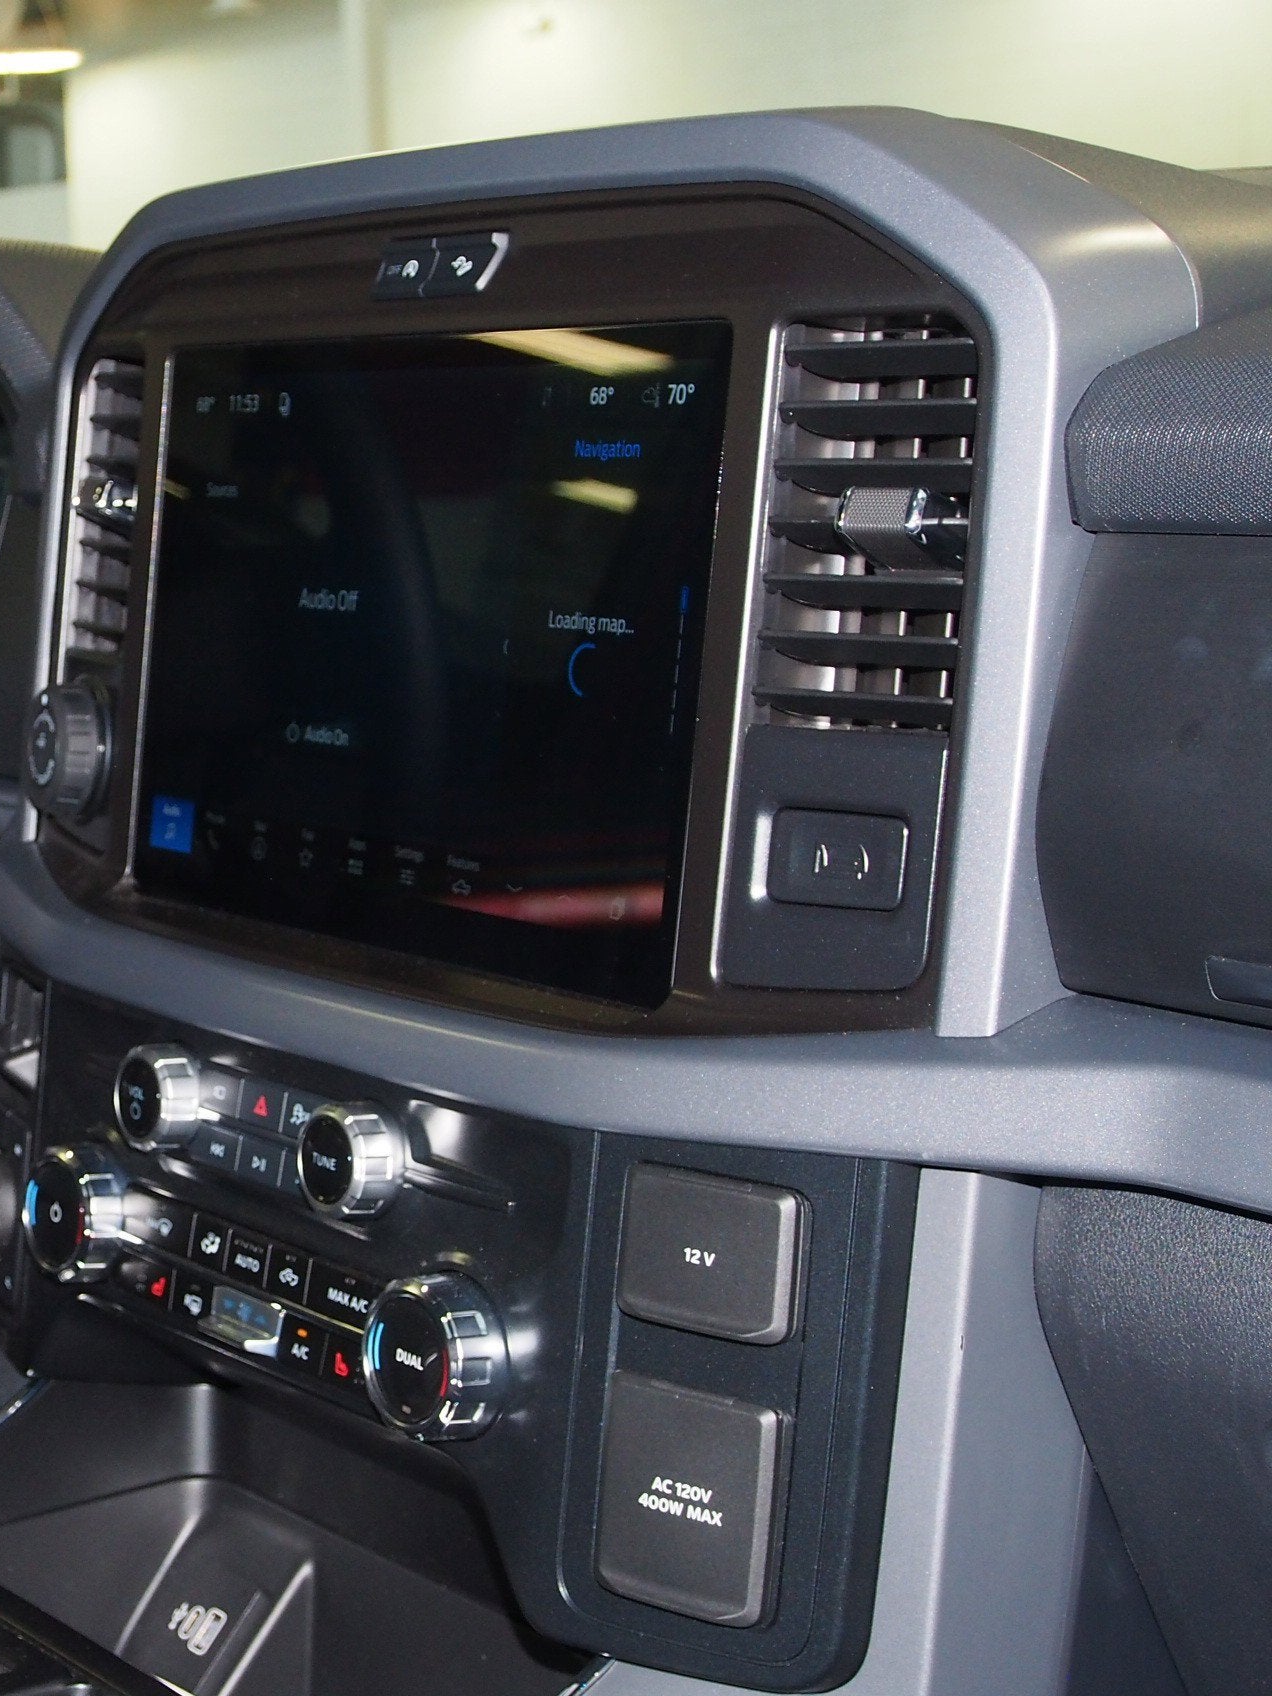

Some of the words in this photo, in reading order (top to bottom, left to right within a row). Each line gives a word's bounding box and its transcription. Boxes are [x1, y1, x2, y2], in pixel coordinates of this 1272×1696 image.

[589, 386, 615, 405] 68°
[667, 383, 695, 405] 70°
[574, 440, 640, 461] Navigation
[298, 587, 336, 610] Audio
[337, 589, 359, 612] Off
[548, 610, 596, 635] Loading
[597, 616, 634, 635] map...
[312, 1151, 337, 1171] TUNE
[234, 1253, 260, 1273] AUTO
[683, 1247, 701, 1265] 12
[703, 1251, 716, 1267] V
[327, 1287, 350, 1306] MAX
[350, 1297, 369, 1313] A/C
[291, 1343, 310, 1360] A/C
[395, 1347, 424, 1371] DUAL
[651, 1476, 673, 1494] AC
[674, 1482, 712, 1504] 120V
[638, 1492, 684, 1516] 400W
[686, 1504, 722, 1527] MAX
